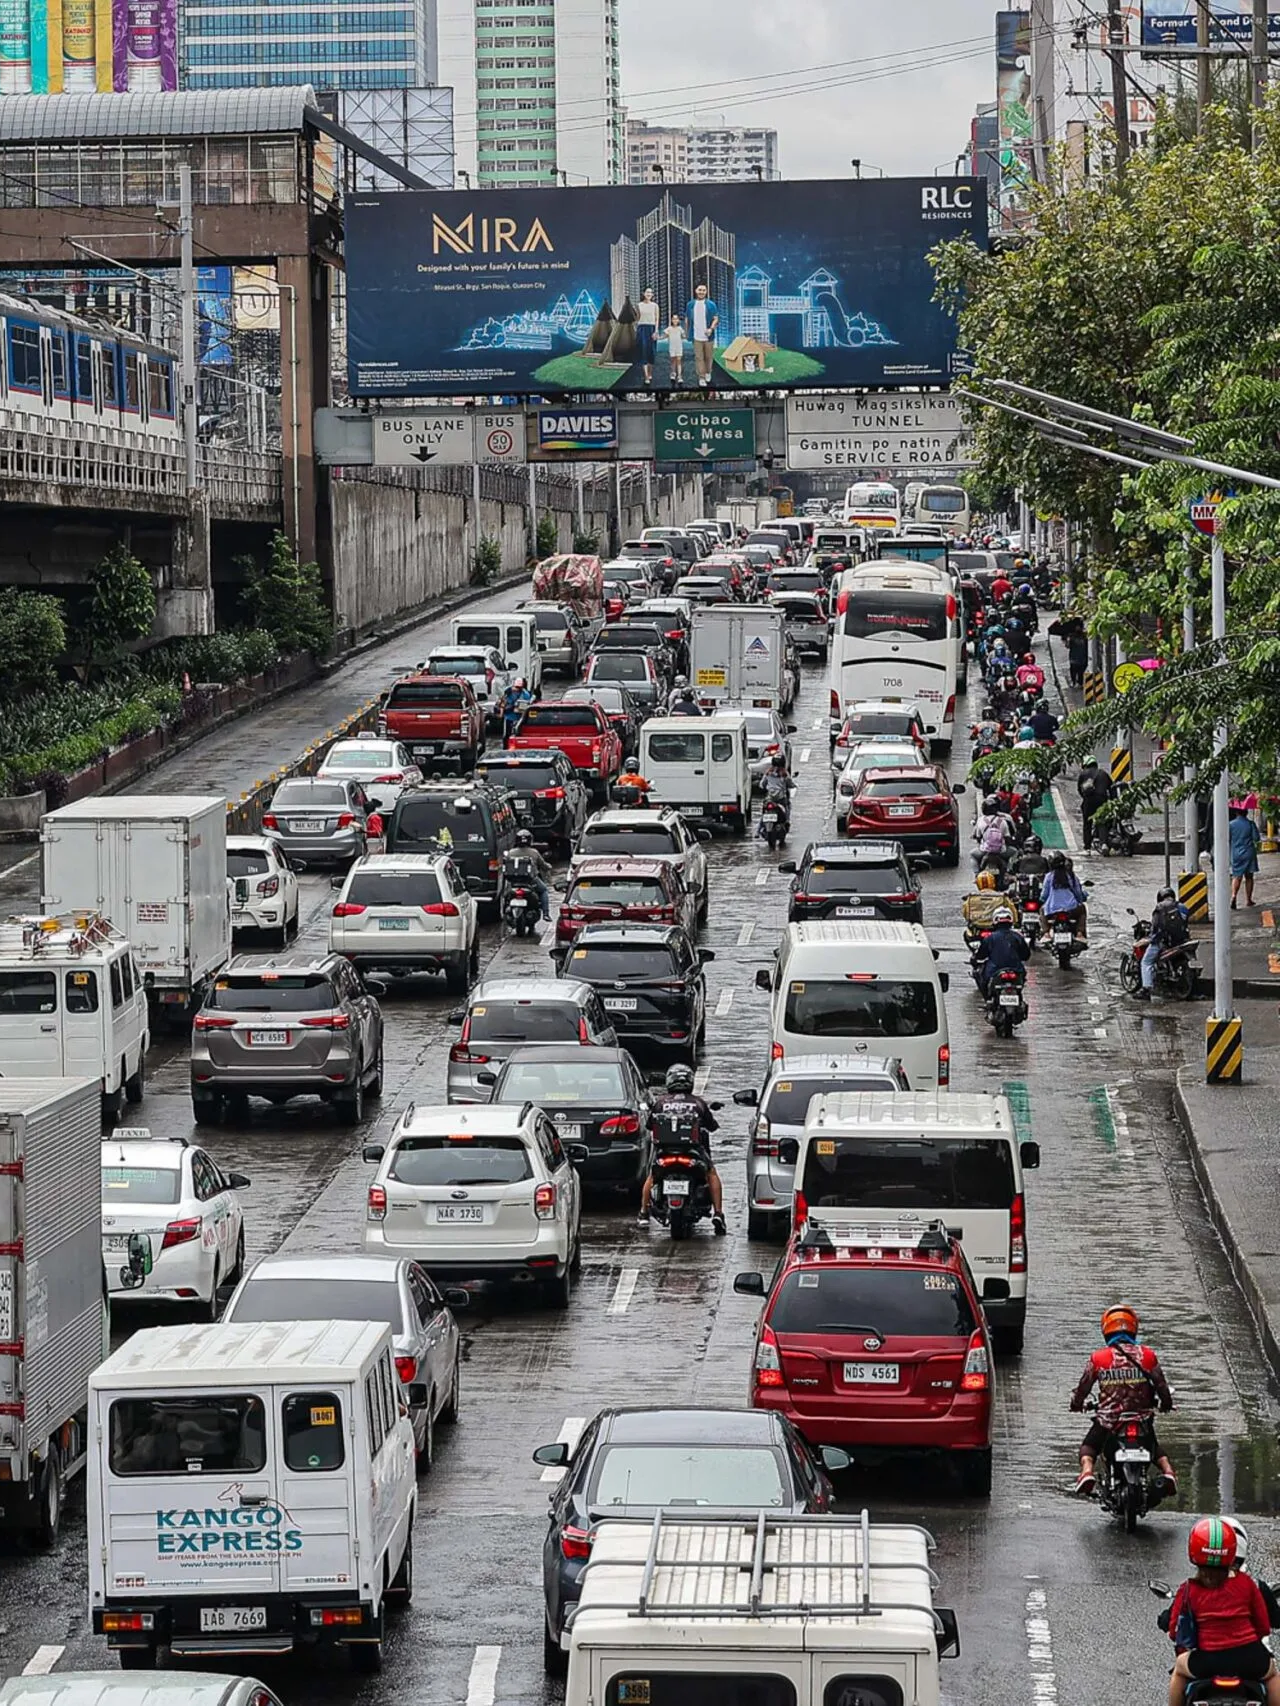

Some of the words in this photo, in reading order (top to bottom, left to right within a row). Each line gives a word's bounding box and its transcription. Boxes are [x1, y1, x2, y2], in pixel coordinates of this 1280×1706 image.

[1151, 18, 1190, 28] Former
[922, 186, 972, 209] RLC
[922, 212, 972, 220] RESIDENCES
[433, 213, 554, 254] MIRA
[417, 264, 452, 273] Designed
[470, 265, 488, 273] your
[489, 262, 516, 272] family's
[518, 261, 539, 270] future
[550, 260, 570, 269] mind
[534, 282, 546, 290] City
[795, 401, 845, 413] Huwag
[382, 421, 413, 432] BUS
[424, 420, 465, 430] LANE
[485, 416, 514, 428] BUS
[542, 416, 613, 433] DAVIES
[677, 414, 731, 426] Cubao
[852, 416, 924, 427] TUNNEL
[403, 434, 444, 444] ONLY
[492, 435, 508, 444] 50
[664, 429, 694, 440] Sta.
[702, 428, 744, 439] Mesa
[800, 438, 862, 451] Gamitin
[872, 440, 889, 453] po
[900, 437, 940, 448] natin
[909, 451, 954, 462] ROAD
[882, 678, 903, 687] 1708
[438, 1208, 454, 1218] NAR
[460, 1208, 480, 1218] 1730
[845, 1364, 865, 1378] NDS
[872, 1365, 898, 1380] 4561
[156, 1506, 282, 1529] KANGO
[158, 1530, 303, 1553] EXPRESS
[203, 1612, 225, 1626] IAB
[234, 1612, 264, 1626] 7669
